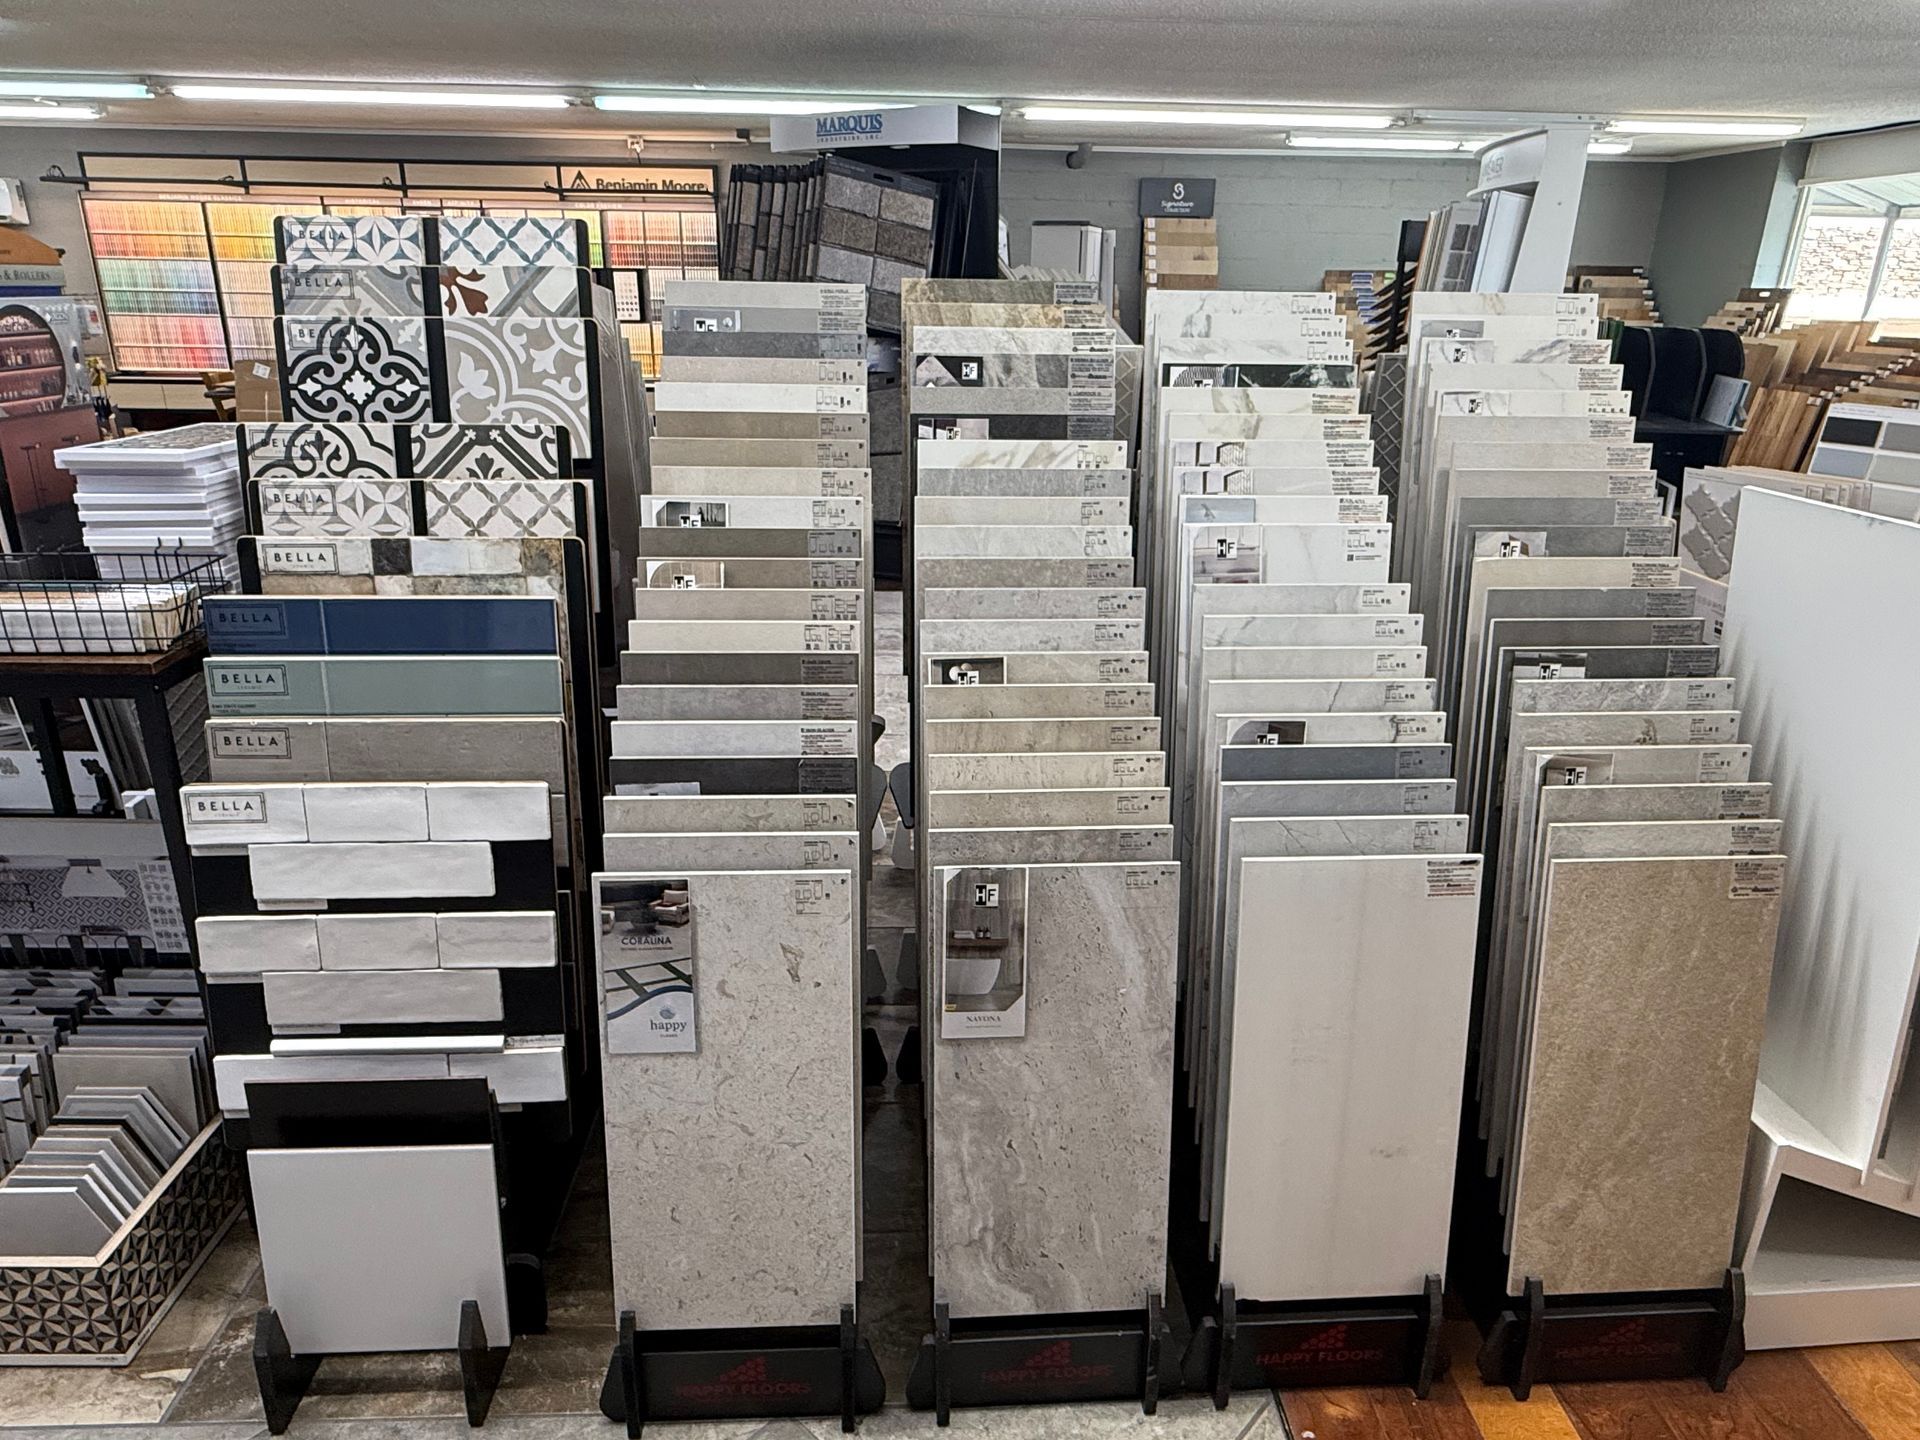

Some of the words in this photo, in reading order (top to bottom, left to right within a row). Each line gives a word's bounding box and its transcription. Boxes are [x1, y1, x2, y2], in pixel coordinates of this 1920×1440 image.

[816, 114, 883, 133] MARQUIS
[596, 178, 658, 191] Benjamin
[662, 180, 705, 191] Moore
[298, 230, 346, 239] BELLA
[294, 278, 343, 287] BELLA
[273, 494, 325, 503] BELLA
[1217, 539, 1236, 558] HF
[273, 552, 327, 562] BELLA
[218, 613, 273, 623] BELLA
[221, 673, 276, 684] BELLA
[223, 736, 279, 746] BELLA
[1565, 768, 1585, 785] HF
[197, 800, 254, 811] BELLA
[975, 885, 998, 906] HF
[621, 935, 672, 946] CORALINA
[650, 1019, 688, 1032] happy
[1255, 1351, 1314, 1366] HAPPY
[1317, 1348, 1384, 1363] FLOORS
